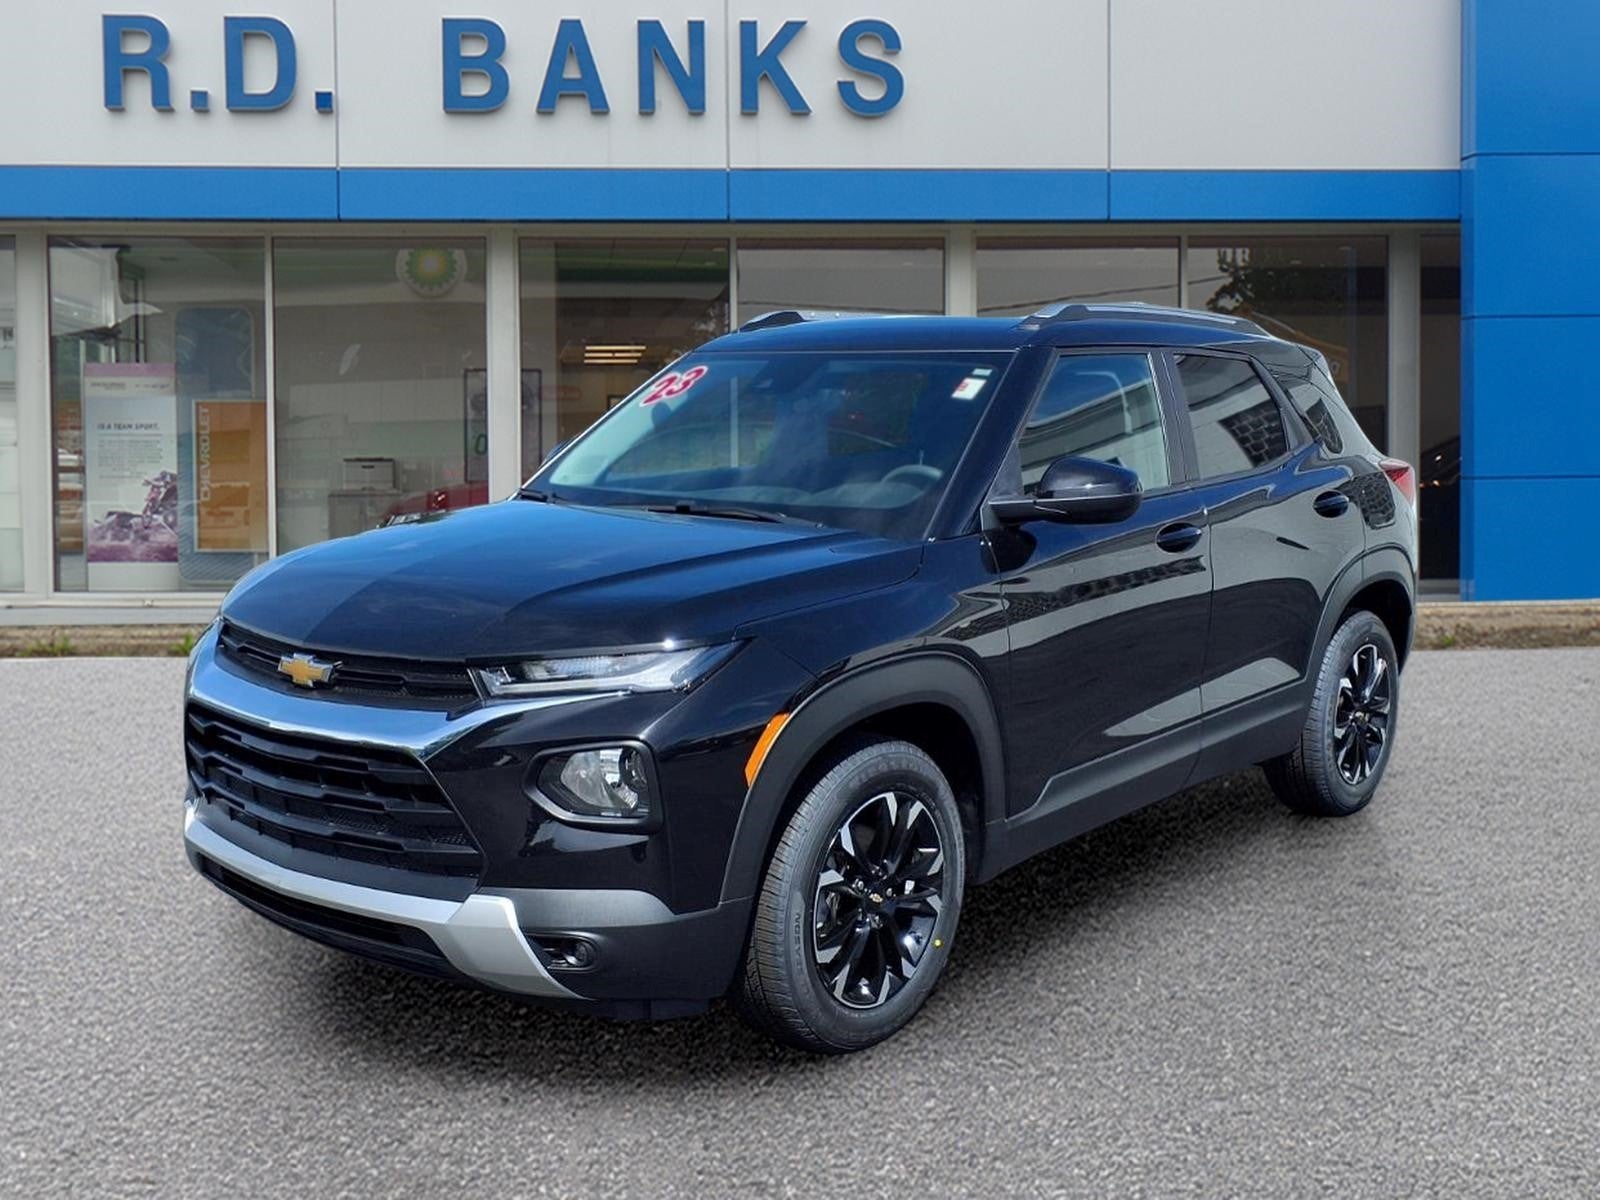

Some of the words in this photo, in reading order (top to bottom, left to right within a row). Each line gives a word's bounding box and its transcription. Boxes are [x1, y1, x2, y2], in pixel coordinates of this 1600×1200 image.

[103, 15, 334, 112] R.D.
[443, 18, 906, 117] BANKS
[641, 366, 707, 406] 23
[113, 422, 133, 431] TEAM
[200, 406, 211, 501] CHEVROLET
